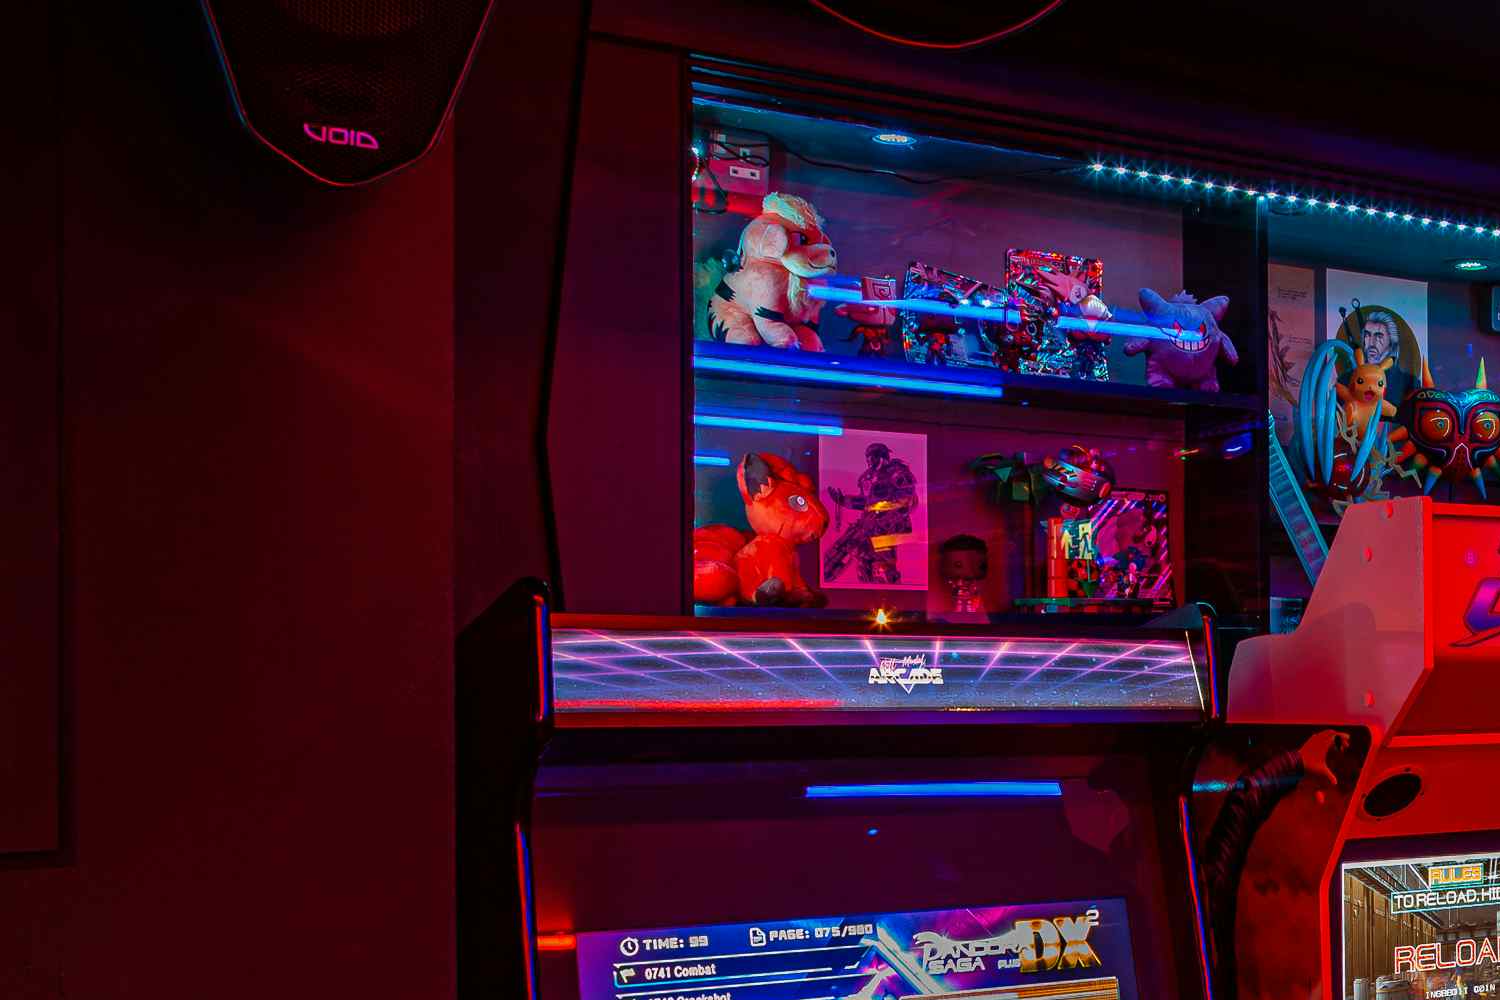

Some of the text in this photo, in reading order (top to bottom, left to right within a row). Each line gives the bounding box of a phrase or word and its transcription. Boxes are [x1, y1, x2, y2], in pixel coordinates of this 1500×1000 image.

[303, 122, 379, 150] VOID
[868, 667, 944, 685] ARCADE
[1430, 867, 1481, 884] RULES
[1394, 894, 1414, 909] TO
[642, 936, 684, 950] TIME:
[768, 927, 810, 942] PAGE:
[644, 963, 717, 981] 0741 Combat
[928, 957, 986, 974] SAGA
